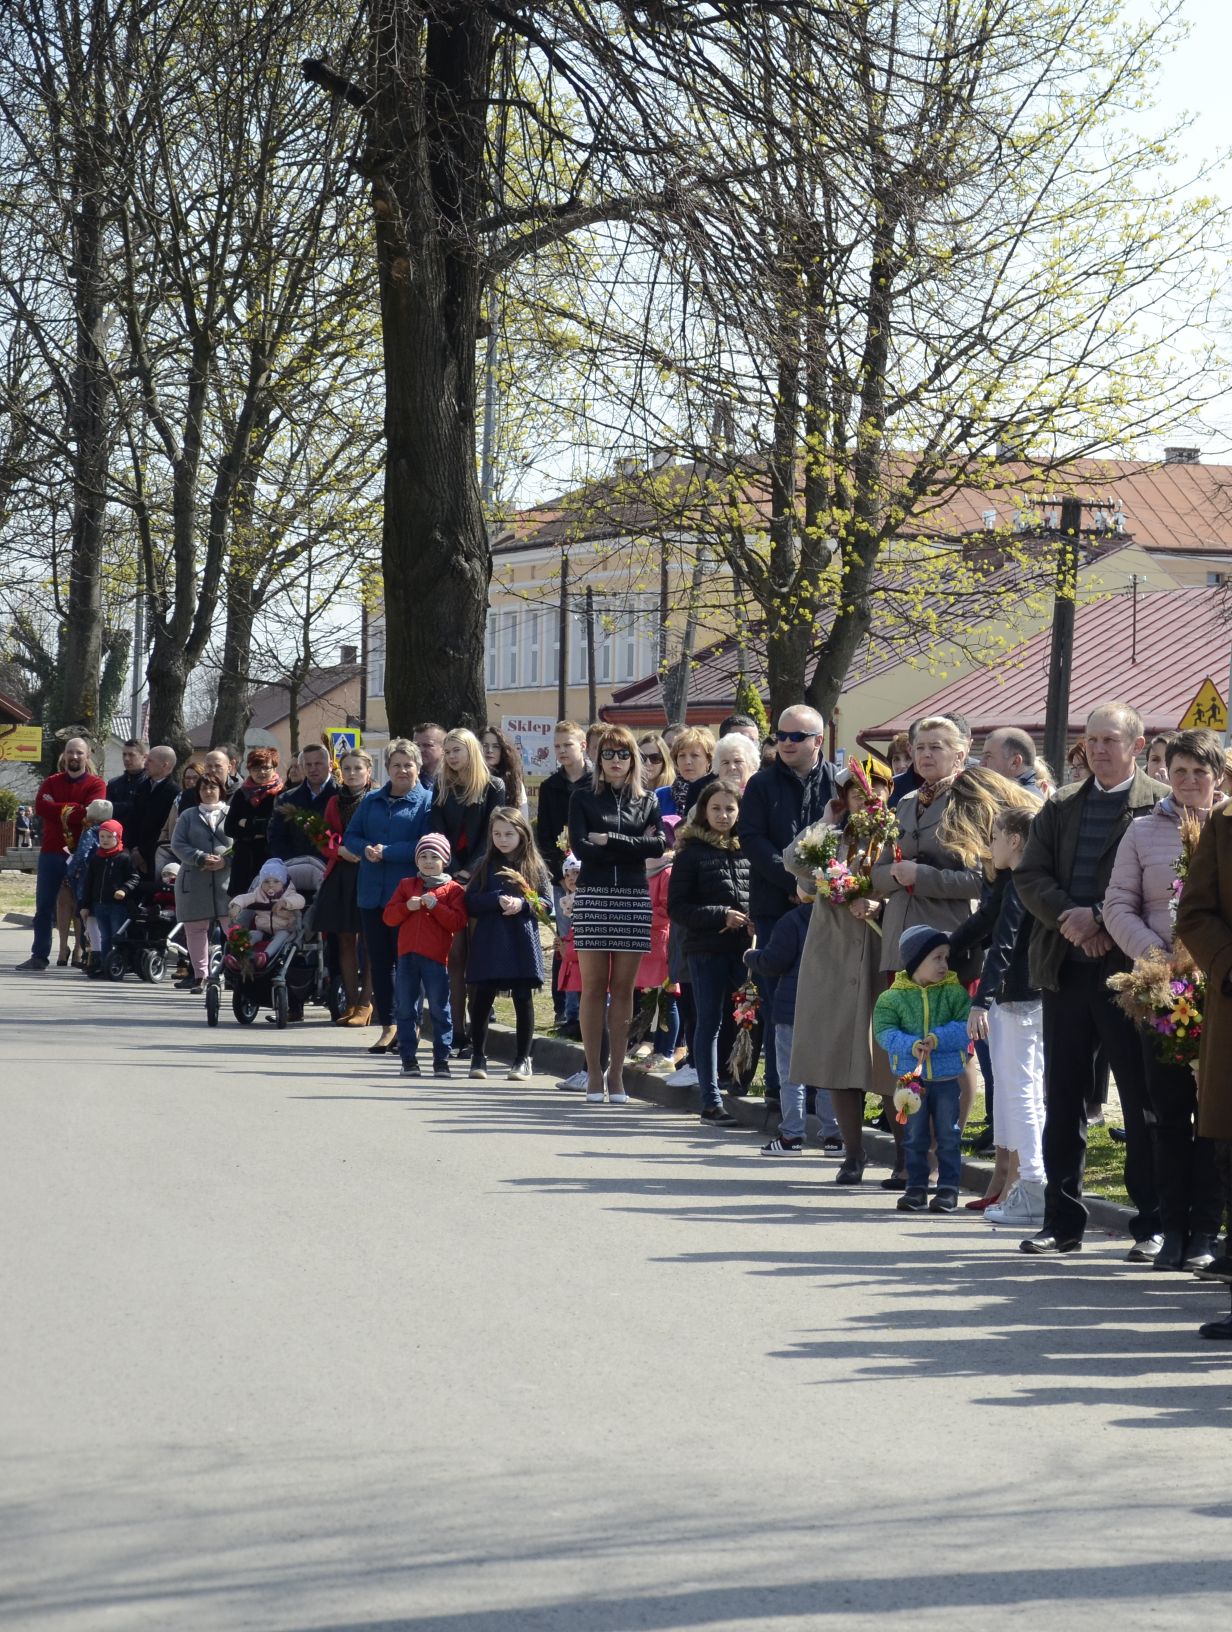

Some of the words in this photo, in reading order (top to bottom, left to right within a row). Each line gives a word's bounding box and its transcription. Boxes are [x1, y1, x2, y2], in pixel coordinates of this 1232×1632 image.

[508, 719, 551, 735] Sklep
[587, 886, 609, 894] PARIS
[610, 887, 632, 895] PARIS
[585, 899, 608, 907] PARIS
[609, 900, 632, 908] PARIS
[608, 913, 632, 921] PARIS
[585, 926, 608, 934] PARIS
[608, 926, 631, 934] PARIS
[585, 939, 607, 947] PARIS
[608, 940, 631, 948] PARIS
